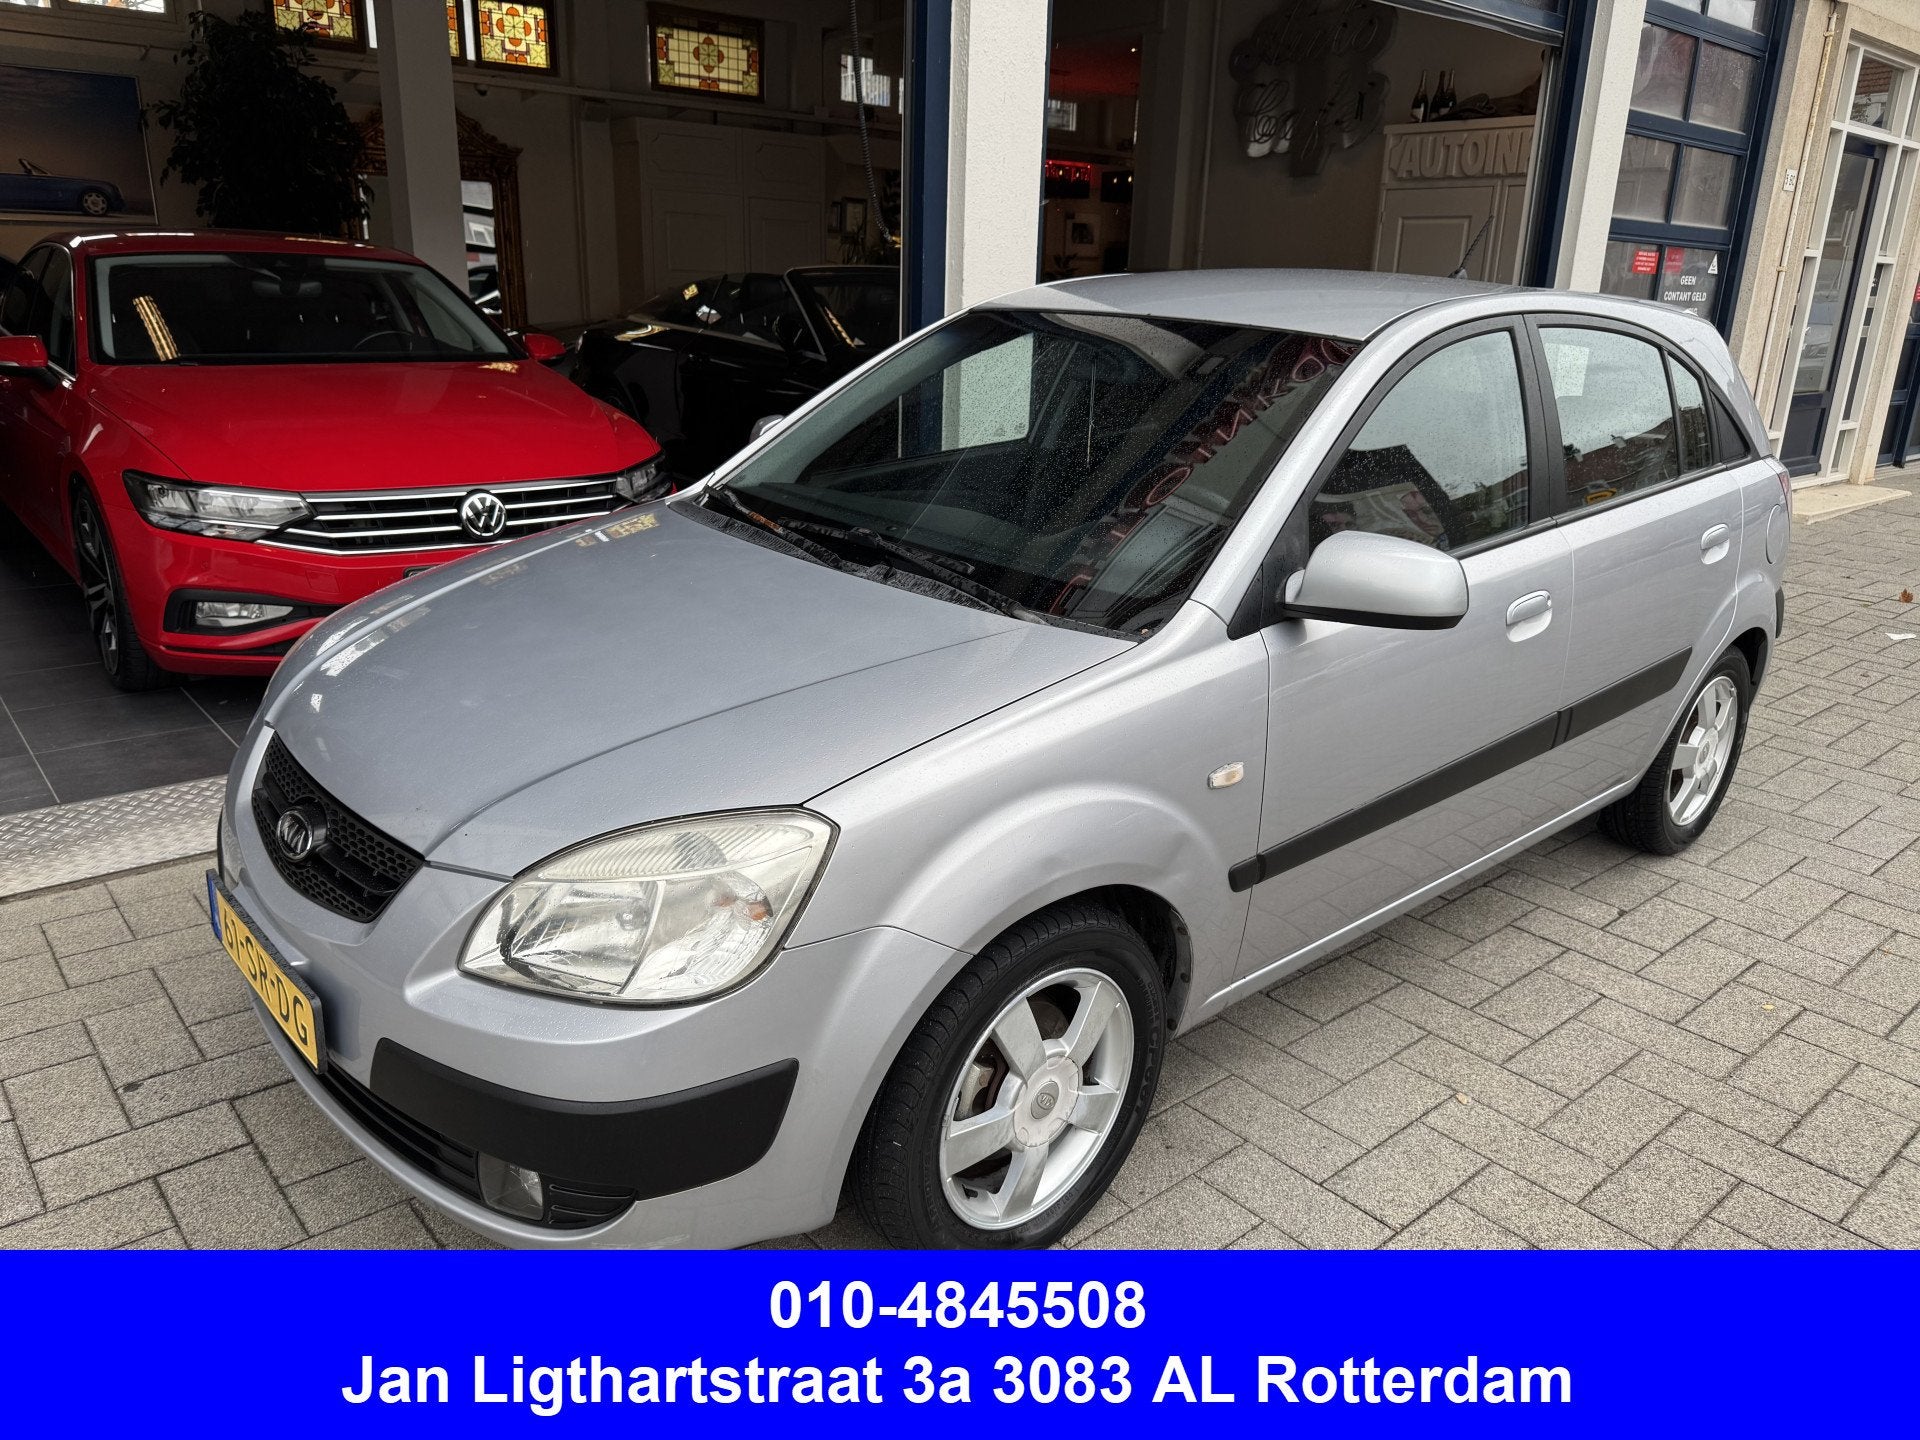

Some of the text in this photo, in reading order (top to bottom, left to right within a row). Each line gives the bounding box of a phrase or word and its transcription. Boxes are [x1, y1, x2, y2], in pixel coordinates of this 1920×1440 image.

[1680, 275, 1697, 285] GEEN
[1663, 291, 1707, 302] CONTANT GELD
[224, 908, 308, 1046] 61-SR-DG
